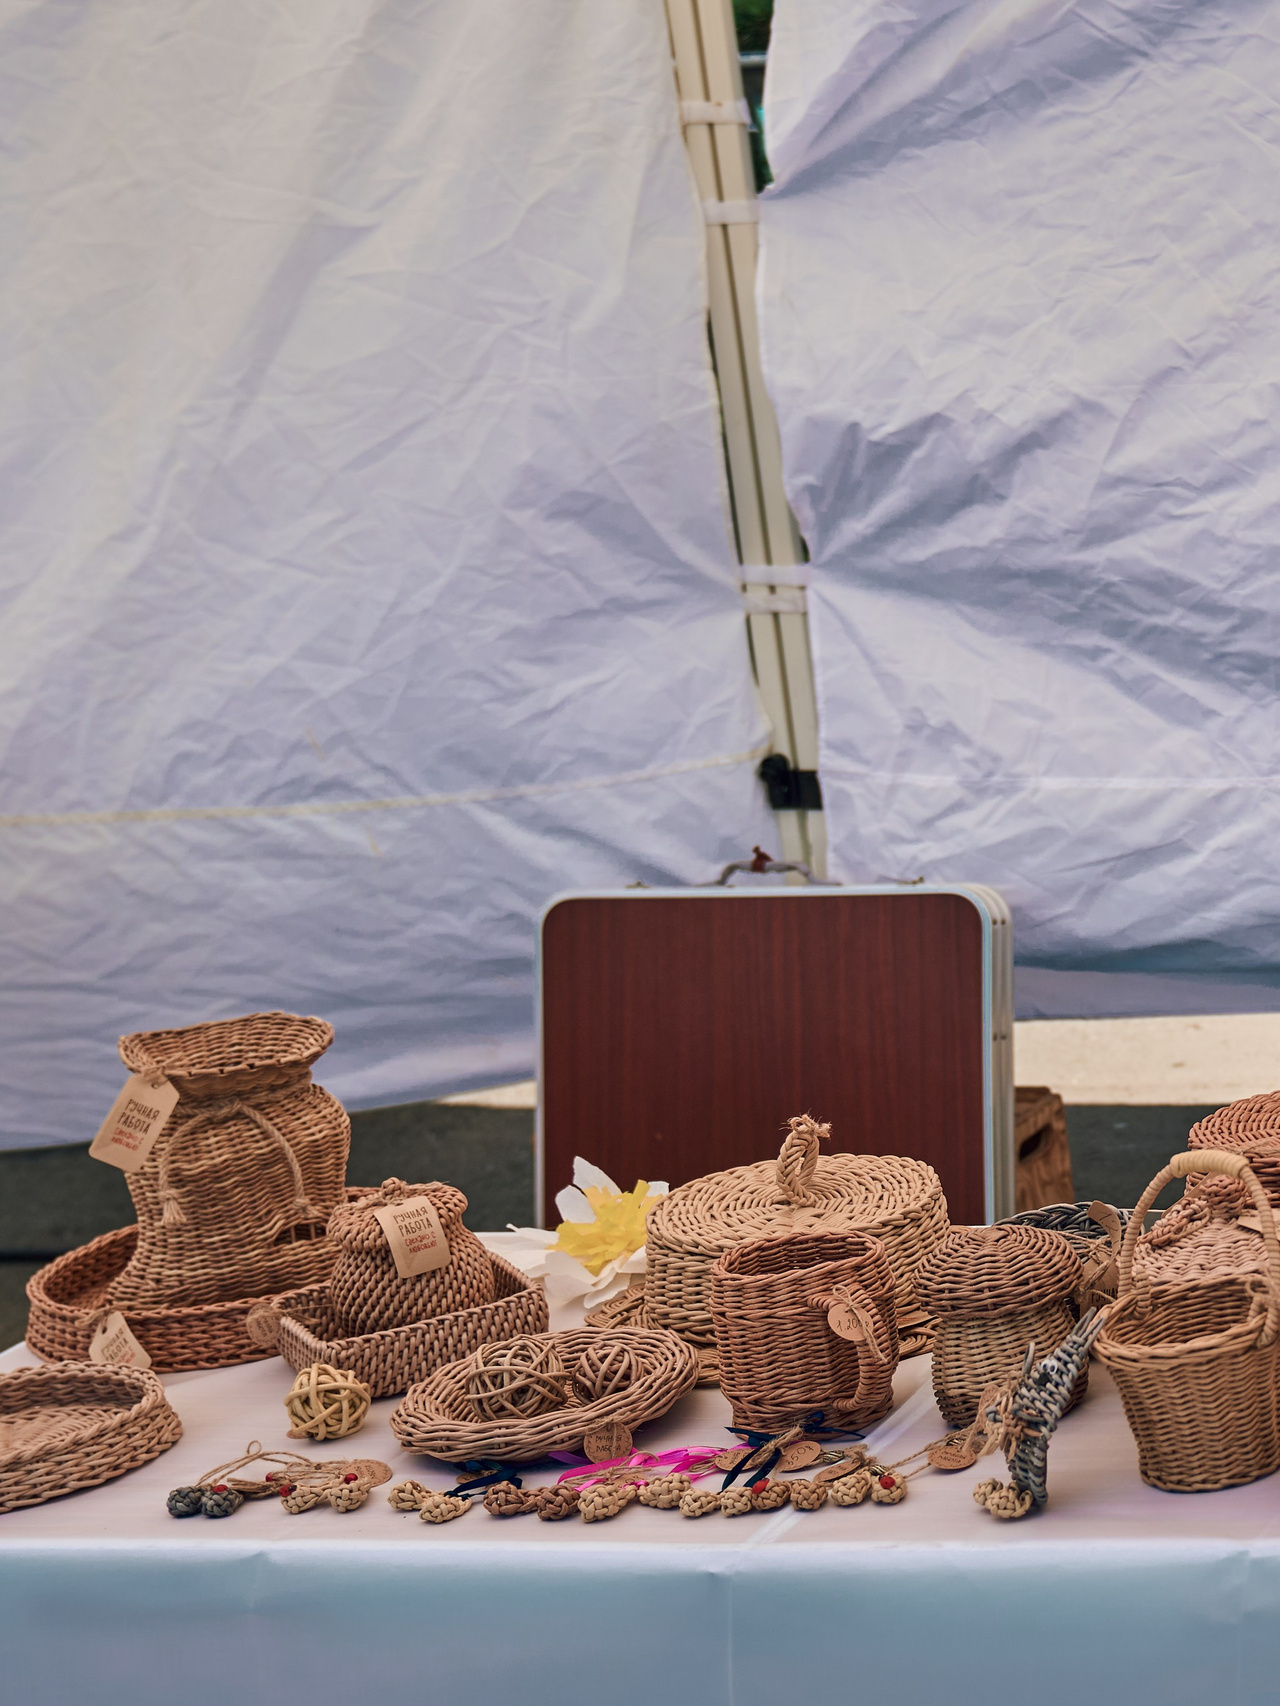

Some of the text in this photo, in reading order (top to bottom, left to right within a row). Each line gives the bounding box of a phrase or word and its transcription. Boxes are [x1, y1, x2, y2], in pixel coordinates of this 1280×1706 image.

[125, 1099, 160, 1121] РУЧНАЯ
[117, 1112, 151, 1135] РАБОТА
[393, 1206, 428, 1224] РУЧНАЯ
[398, 1217, 433, 1237] РАБОТА
